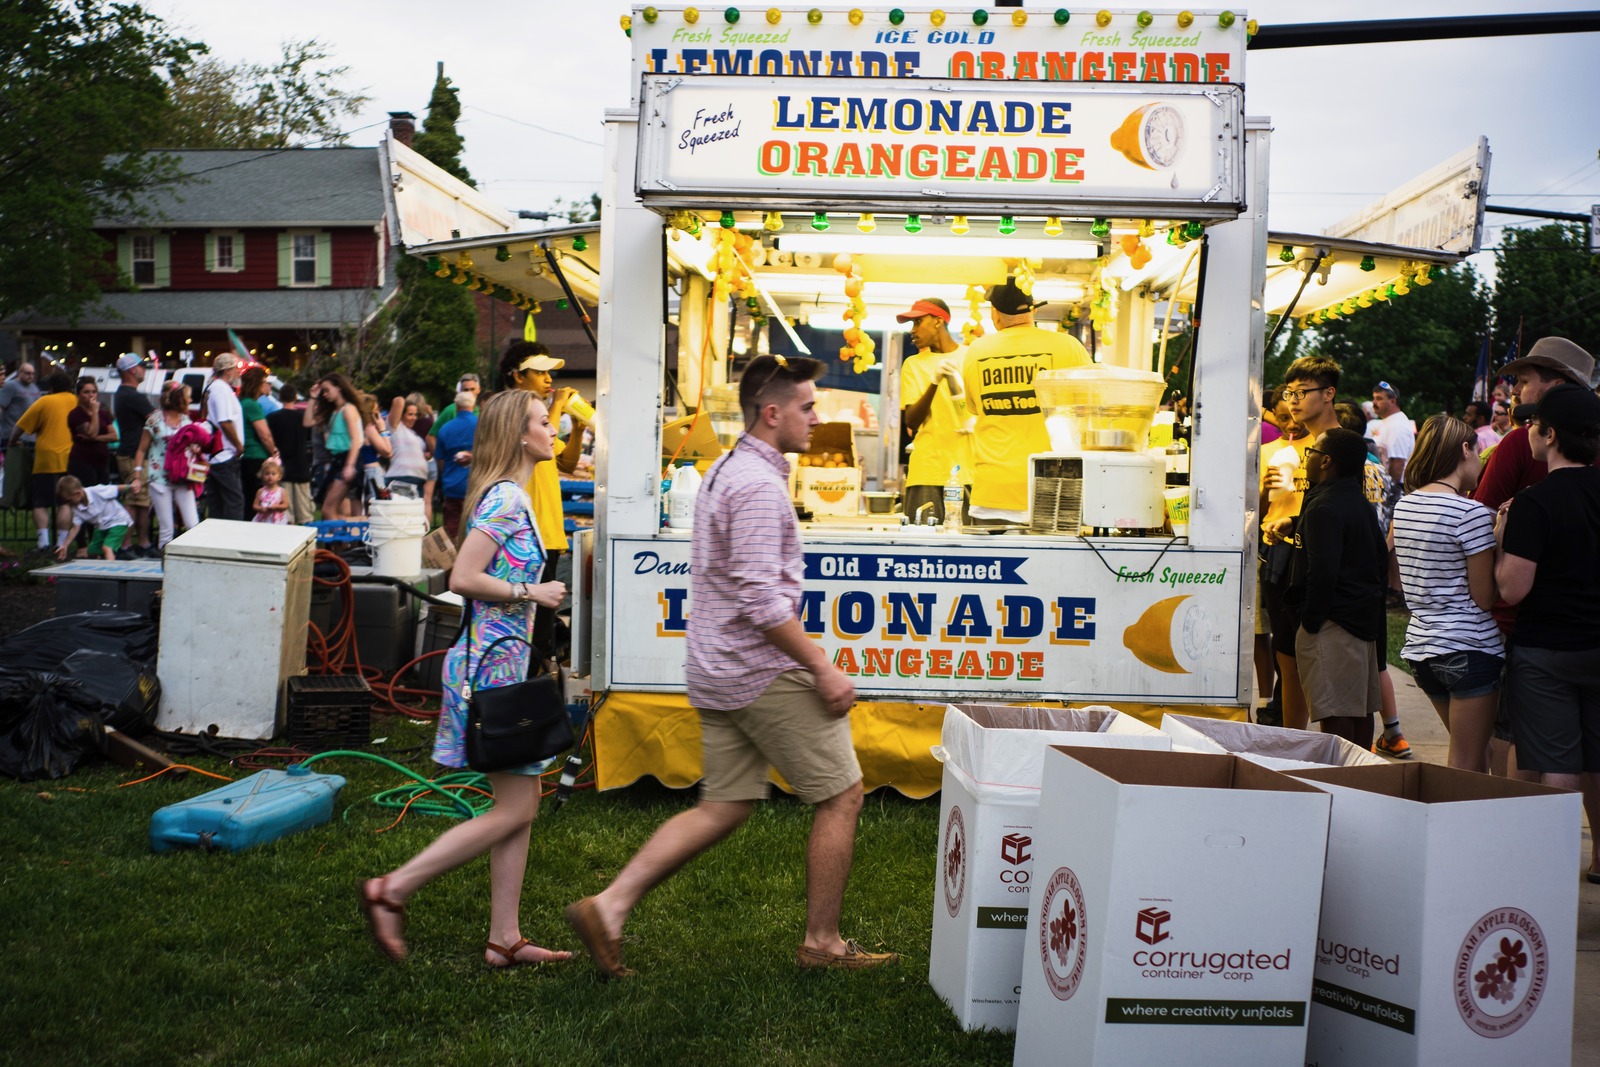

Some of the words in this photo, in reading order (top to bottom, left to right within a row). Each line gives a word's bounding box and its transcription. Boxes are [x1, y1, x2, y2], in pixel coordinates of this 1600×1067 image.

[672, 28, 711, 44] Fresh
[718, 26, 791, 47] Squeezed
[874, 28, 918, 44] ICE
[926, 29, 995, 45] COLD
[1080, 31, 1121, 48] Fresh
[1128, 29, 1201, 51] Squeezed
[646, 48, 920, 77] LEMONADE
[948, 50, 1230, 82] ORANGEADE
[693, 103, 734, 130] Fresh
[773, 95, 1072, 137] LEMONADE
[678, 120, 740, 155] Squeezed
[758, 139, 1085, 184] ORANGEADE
[982, 362, 1048, 387] Danny'
[983, 396, 1012, 410] Fine
[1015, 396, 1040, 410] Foo
[633, 551, 692, 575] Dan
[820, 556, 860, 577] Old
[877, 558, 1002, 581] Fashioned
[1116, 566, 1154, 583] Fresh
[1160, 567, 1227, 588] Squeezed
[823, 647, 1045, 681] ANGEADE
[1055, 871, 1070, 887] APPLE
[1069, 876, 1086, 930] BLOSSOM
[1133, 948, 1291, 974] corrugated
[1345, 963, 1371, 979] corp.
[1456, 934, 1479, 1020] SHENANDOAH
[1478, 911, 1506, 937] APPLE
[1507, 911, 1544, 952] BLOSSOM
[1141, 968, 1205, 979] container
[1223, 970, 1254, 983] corp.
[1121, 1004, 1168, 1016] where
[1171, 1005, 1239, 1020] creativity
[1242, 1006, 1294, 1020] unfolds
[1362, 1001, 1405, 1023] unfolds
